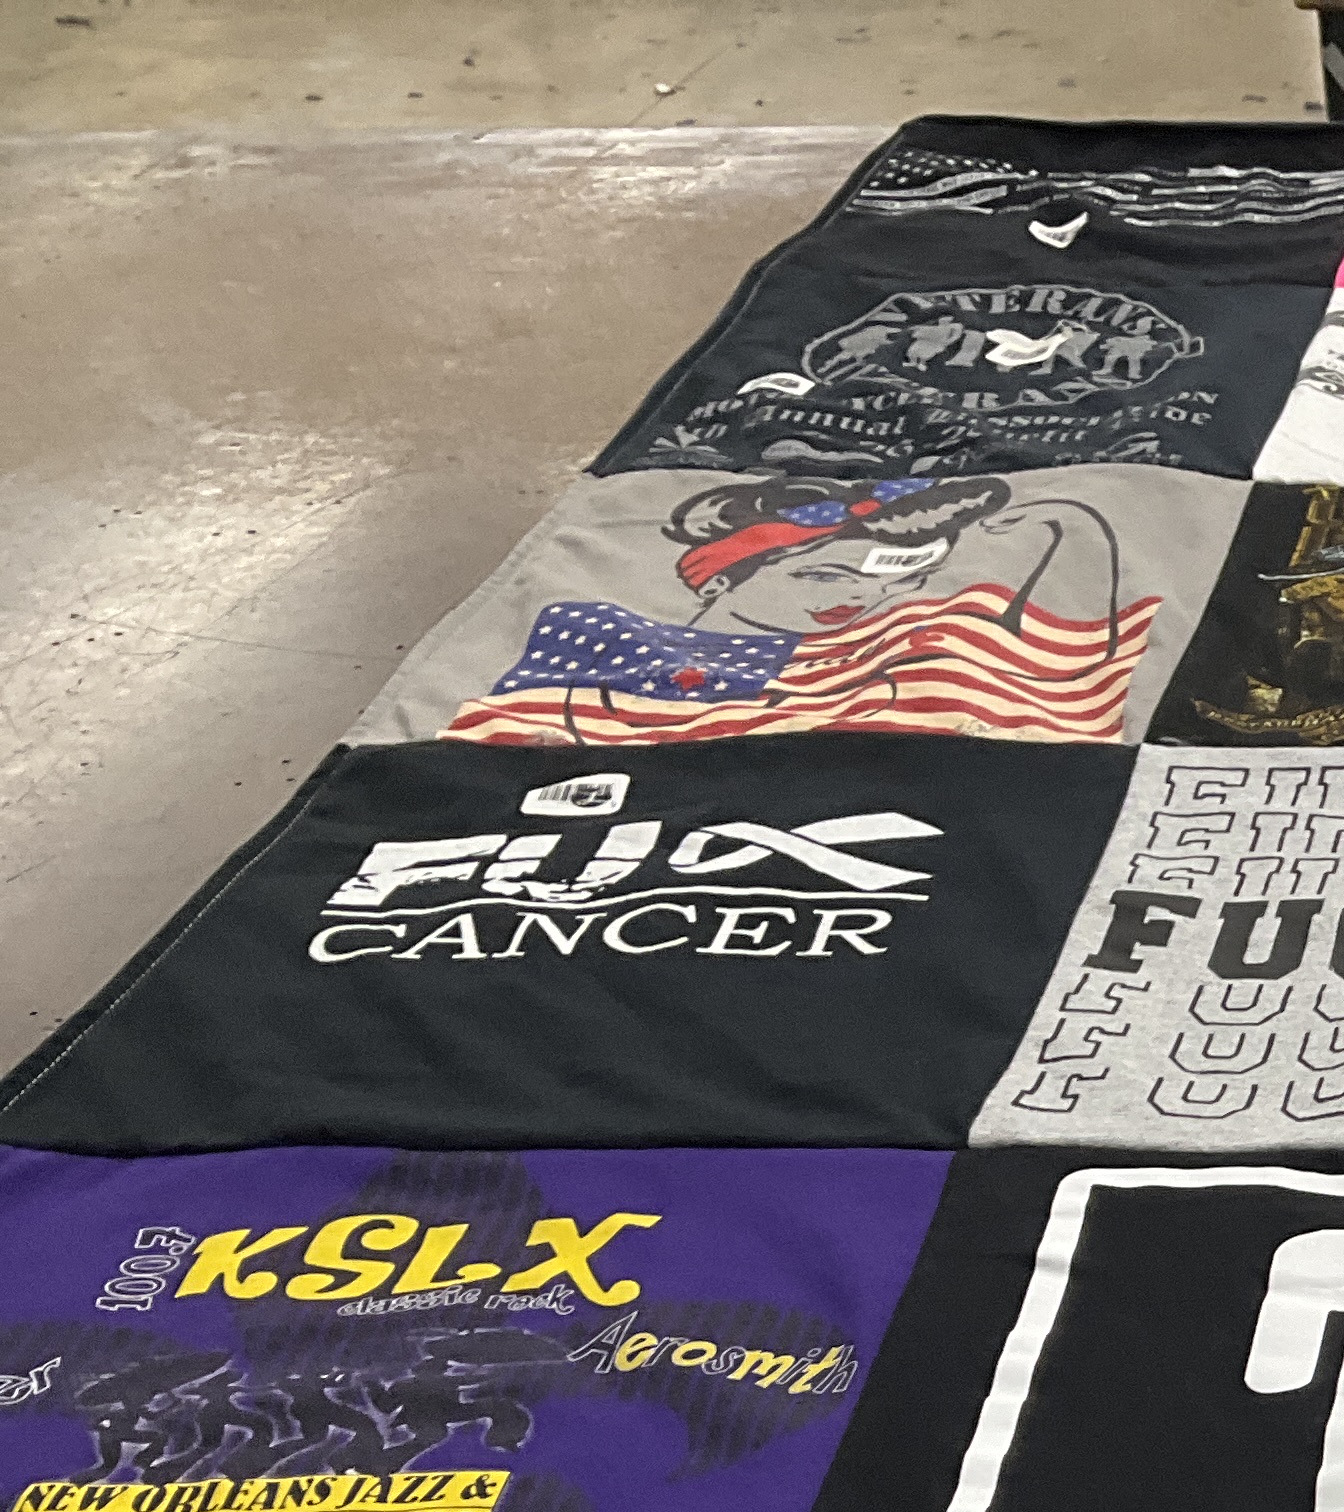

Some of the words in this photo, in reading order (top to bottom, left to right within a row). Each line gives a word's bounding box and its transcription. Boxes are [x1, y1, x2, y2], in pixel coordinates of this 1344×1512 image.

[306, 903, 894, 963] CANCER
[173, 1212, 662, 1307] KSLX
[336, 1284, 479, 1317] classic
[484, 1284, 576, 1316] rock
[565, 1310, 860, 1395] Aerosmith
[338, 1474, 449, 1510] JAZZ
[459, 1473, 498, 1500] &
